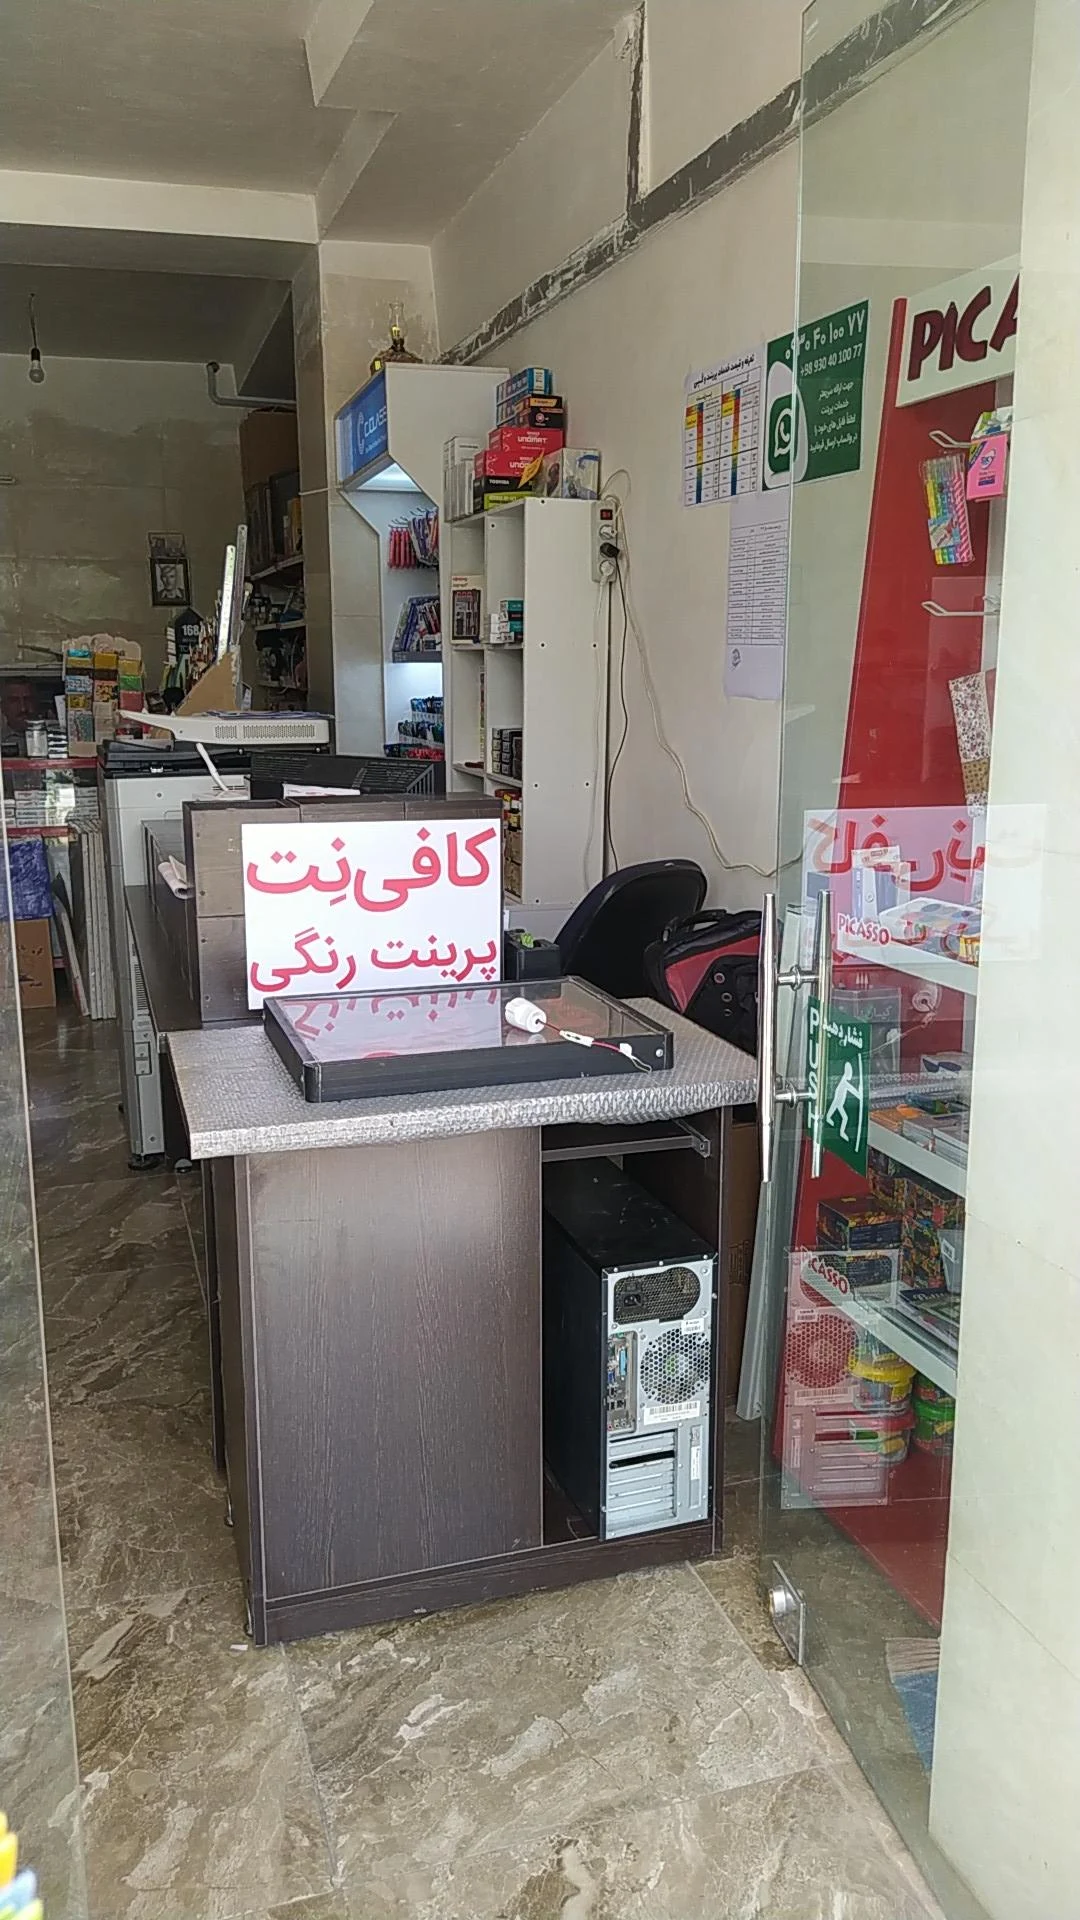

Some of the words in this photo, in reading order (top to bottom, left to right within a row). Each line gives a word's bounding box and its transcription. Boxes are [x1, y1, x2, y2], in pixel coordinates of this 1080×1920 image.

[814, 356, 827, 372] 930
[828, 352, 837, 366] 40
[838, 347, 852, 364] 100
[852, 342, 863, 358] 77
[182, 624, 200, 637] 168
[353, 826, 497, 912] کافی
[838, 914, 890, 945] PICASSO
[250, 926, 357, 993] رنگی
[370, 935, 497, 982] پرینت
